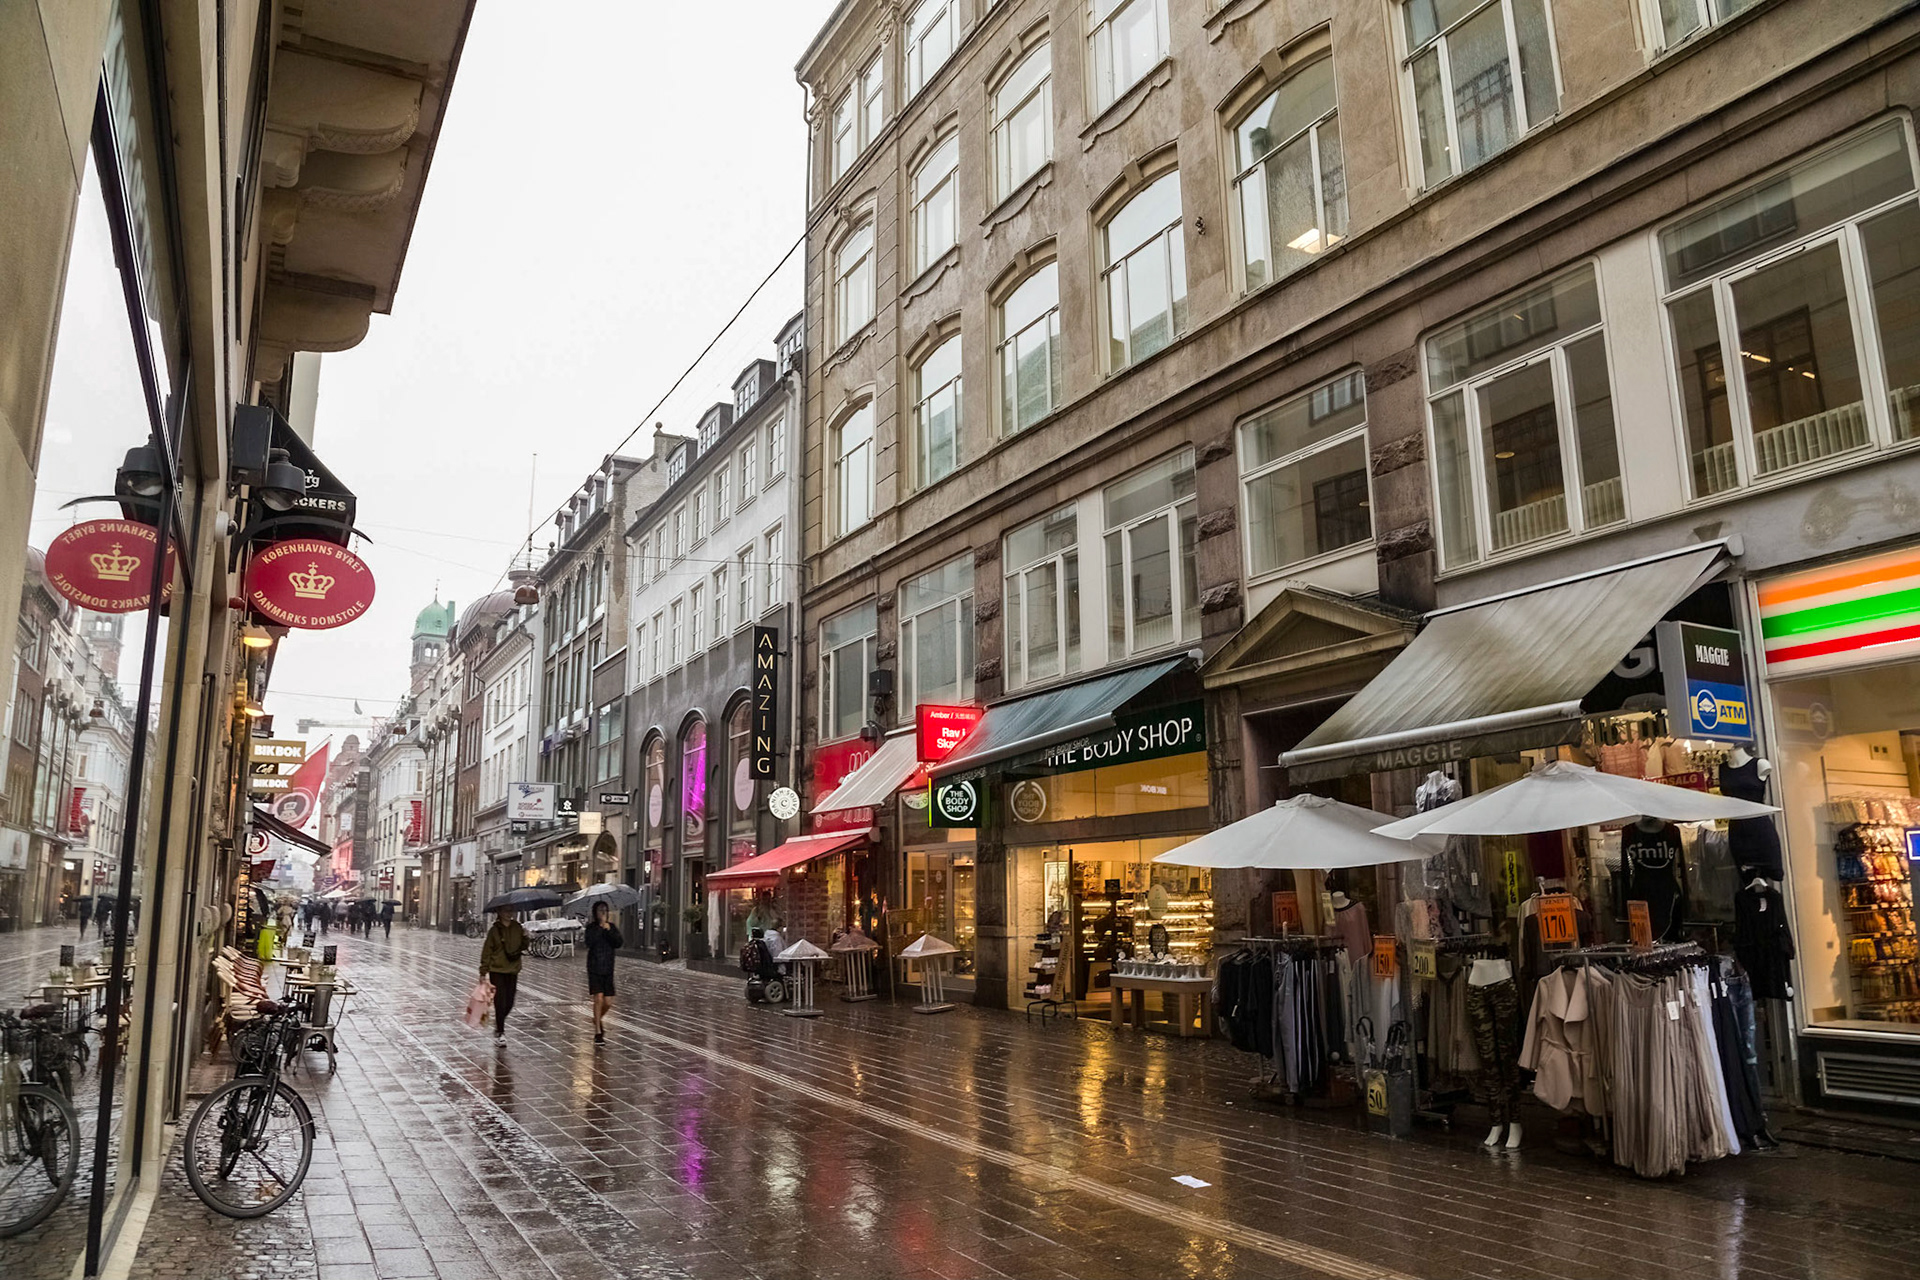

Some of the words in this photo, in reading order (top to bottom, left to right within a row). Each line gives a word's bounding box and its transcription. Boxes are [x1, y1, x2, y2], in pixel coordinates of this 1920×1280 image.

[262, 543, 333, 565] KØBENHAVNS
[335, 551, 365, 574] BYRET
[253, 590, 307, 625] DANMARKS
[311, 600, 365, 626] DOMSTOLE
[1695, 644, 1730, 667] MAGGIE
[757, 633, 773, 774] AMAZING
[1719, 704, 1745, 720] ATM
[930, 711, 950, 719] Amber
[942, 727, 960, 738] Rav
[1083, 728, 1134, 762] BODY
[1138, 717, 1192, 752] SHOP
[254, 744, 276, 756] BIK
[276, 745, 302, 758] BOK
[1056, 742, 1072, 756] BODY
[252, 778, 269, 788] BIK
[269, 779, 289, 789] BOK
[945, 797, 969, 805] BODY
[946, 805, 969, 813] SHOP
[1544, 914, 1567, 939] 170
[1375, 953, 1390, 974] 150
[1414, 955, 1429, 975] 200
[1369, 1088, 1383, 1110] 50
